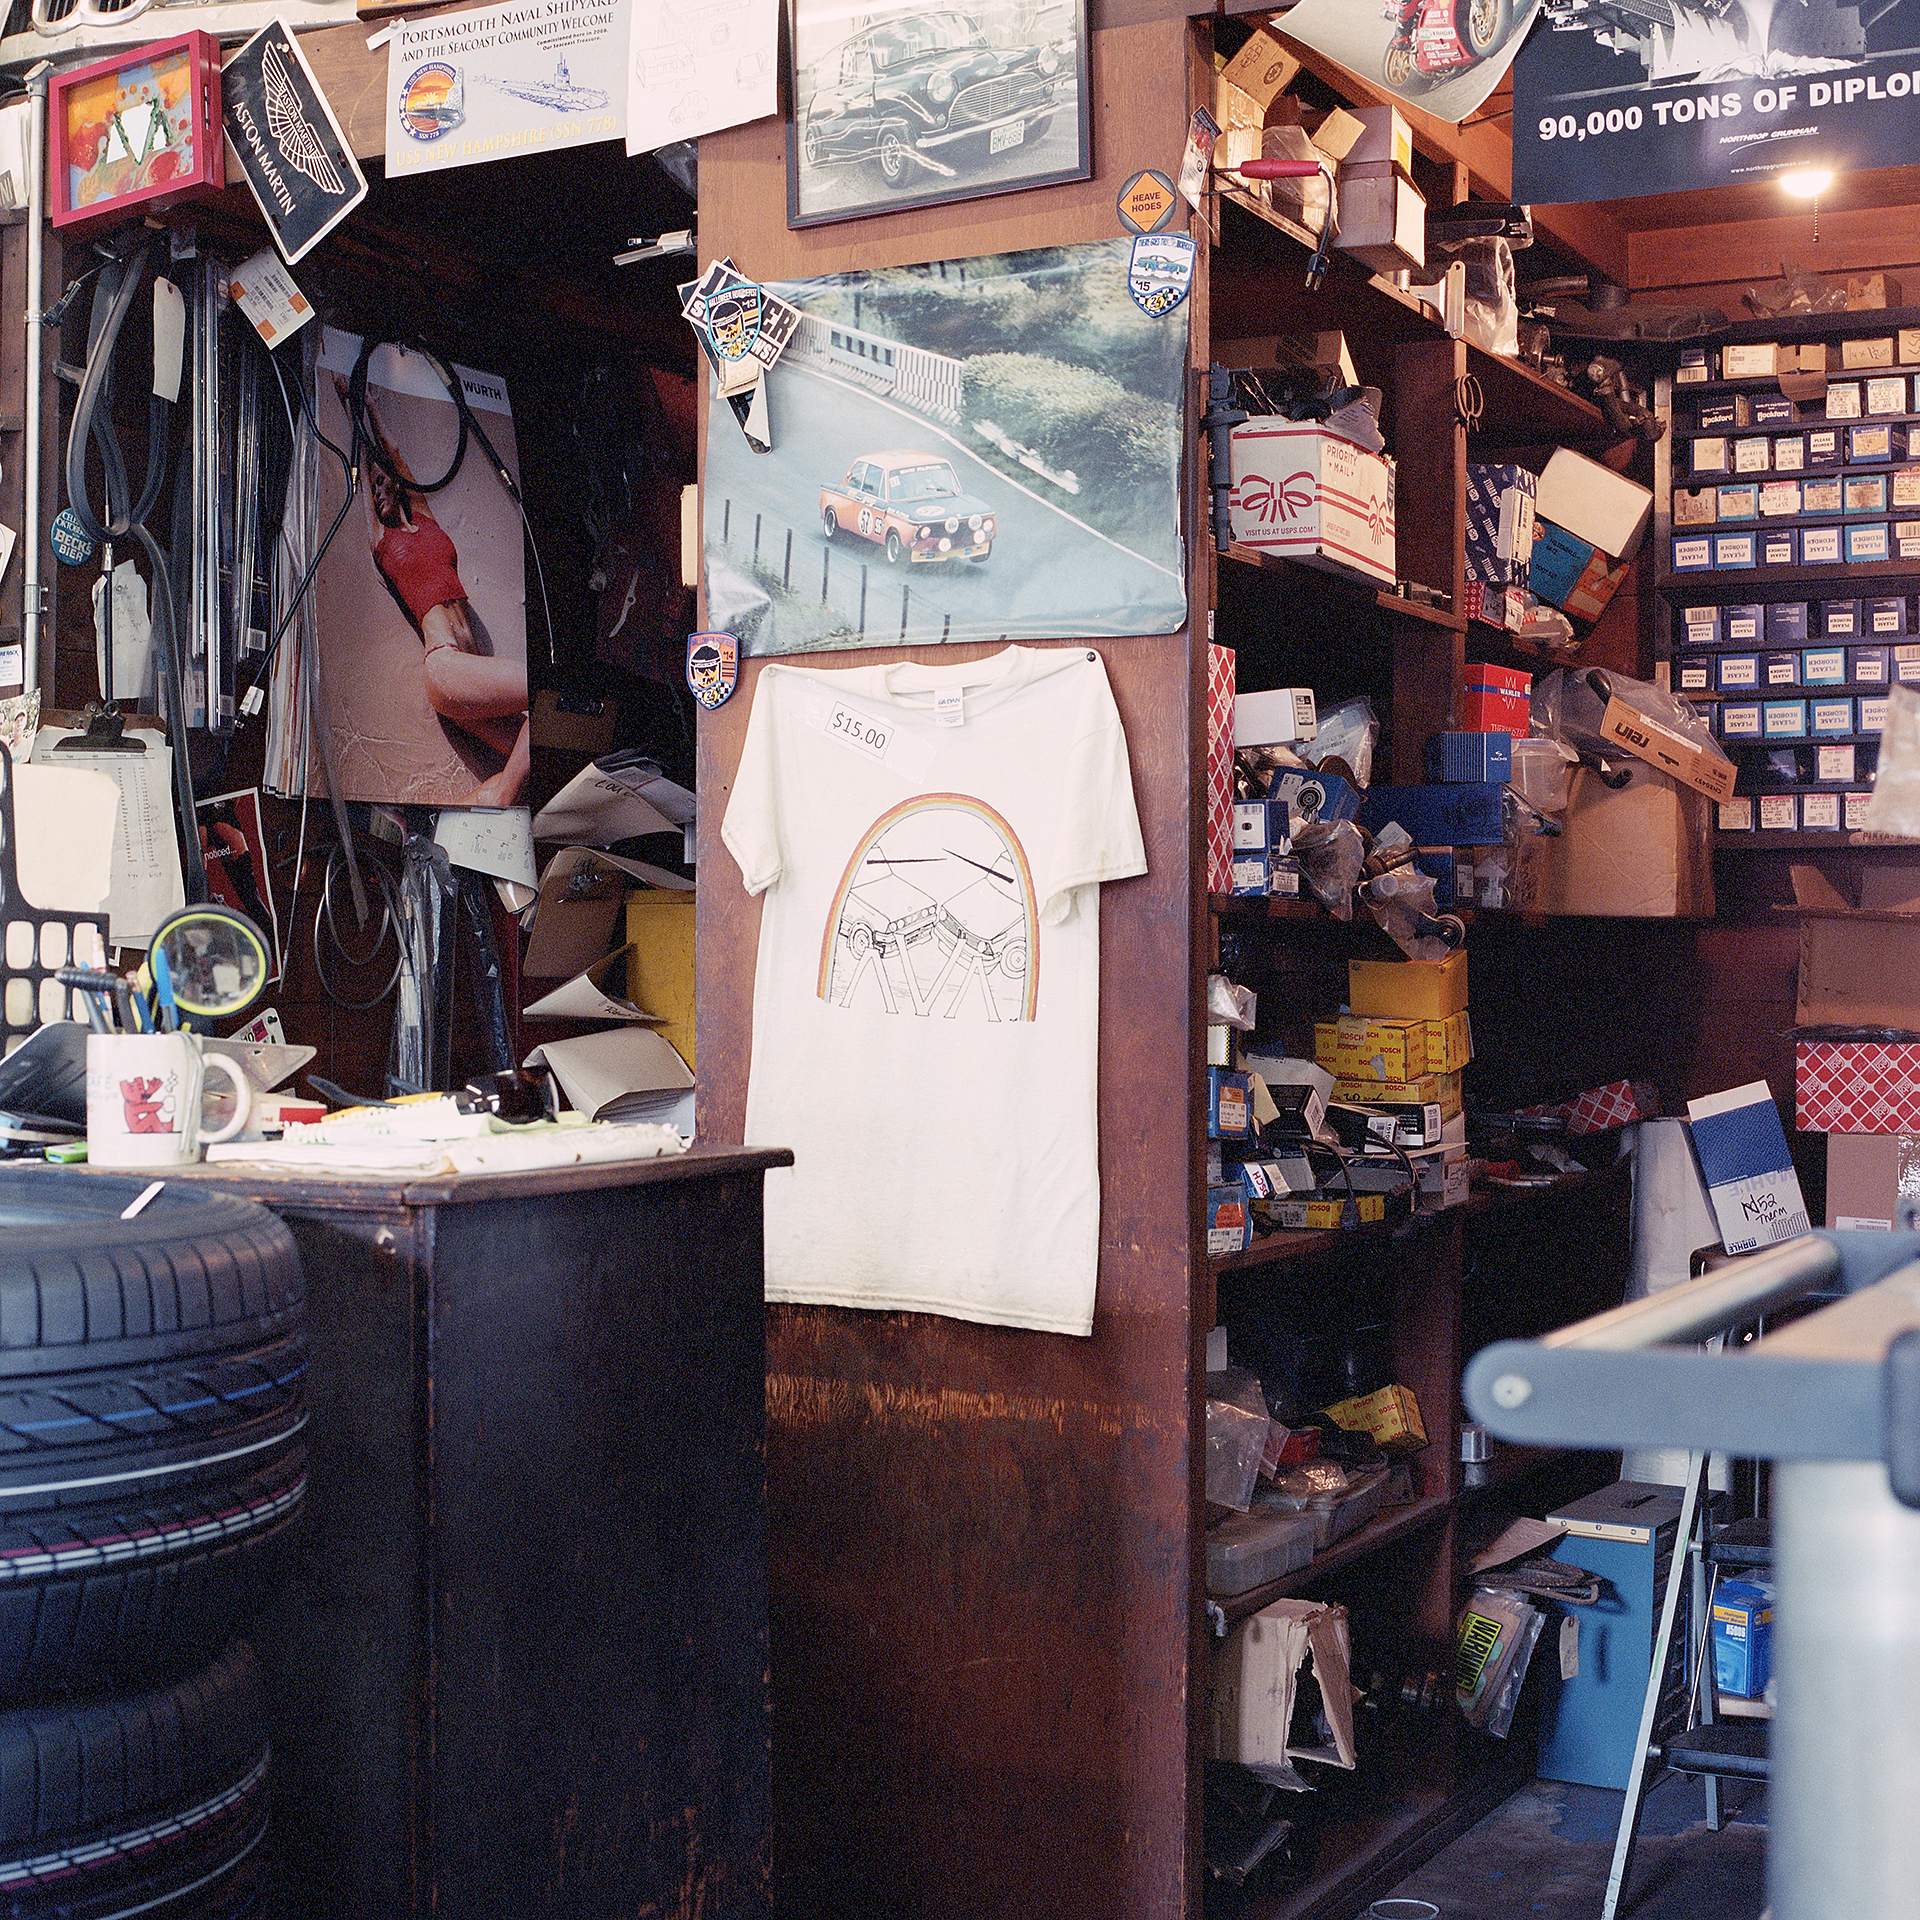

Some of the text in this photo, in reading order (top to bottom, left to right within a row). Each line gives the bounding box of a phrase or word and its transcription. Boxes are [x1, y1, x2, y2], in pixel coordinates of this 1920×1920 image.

[402, 17, 496, 45] PORTSMOUTH
[501, 7, 542, 26] NAVAL
[401, 12, 613, 62] AND THE SEACOAST COMMUNITY WELCOME
[536, 34, 571, 46] Commissioned
[553, 40, 576, 49] Seacoast
[576, 36, 602, 45] Treasure.
[407, 76, 422, 87] USS
[416, 64, 429, 77] NEW
[1538, 72, 1920, 142] 90,000 TONS OF DIPLO
[280, 92, 316, 156] ASTON MARTIN
[397, 116, 617, 167] USS NEW HAMPSHIRE (SSN 778)
[429, 130, 439, 138] 778
[1719, 126, 1818, 144] NORTHROP GRUMMAN
[232, 101, 297, 216] ASTON MARTIN
[1730, 160, 1811, 174] www.northropgrumman.com
[1132, 192, 1161, 202] HEAVE
[1131, 202, 1162, 212] HODES
[1702, 413, 1734, 428] Rockford
[1757, 410, 1789, 422] Rockford
[1326, 445, 1358, 467] PRIORITY
[1333, 461, 1350, 477] MAIL
[1245, 528, 1261, 537] VISIT
[1261, 528, 1270, 536] US
[1271, 527, 1280, 536] AT
[1853, 535, 1884, 543] REORDER
[54, 528, 92, 556] BECK'S
[1806, 537, 1836, 545] REORDER
[59, 543, 83, 562] BIER
[1499, 687, 1521, 698] WAHLER
[832, 712, 886, 750] $15.00
[1615, 721, 1650, 748] rein
[204, 845, 238, 861] noticed...
[1340, 1033, 1364, 1042] BOSCH
[1337, 1043, 1358, 1051] BOSCH
[1380, 1046, 1401, 1054] BOSCH
[1341, 1081, 1362, 1089] BOSCH
[1728, 1237, 1757, 1253] MAHLE
[1459, 1621, 1500, 1688] WARNING
